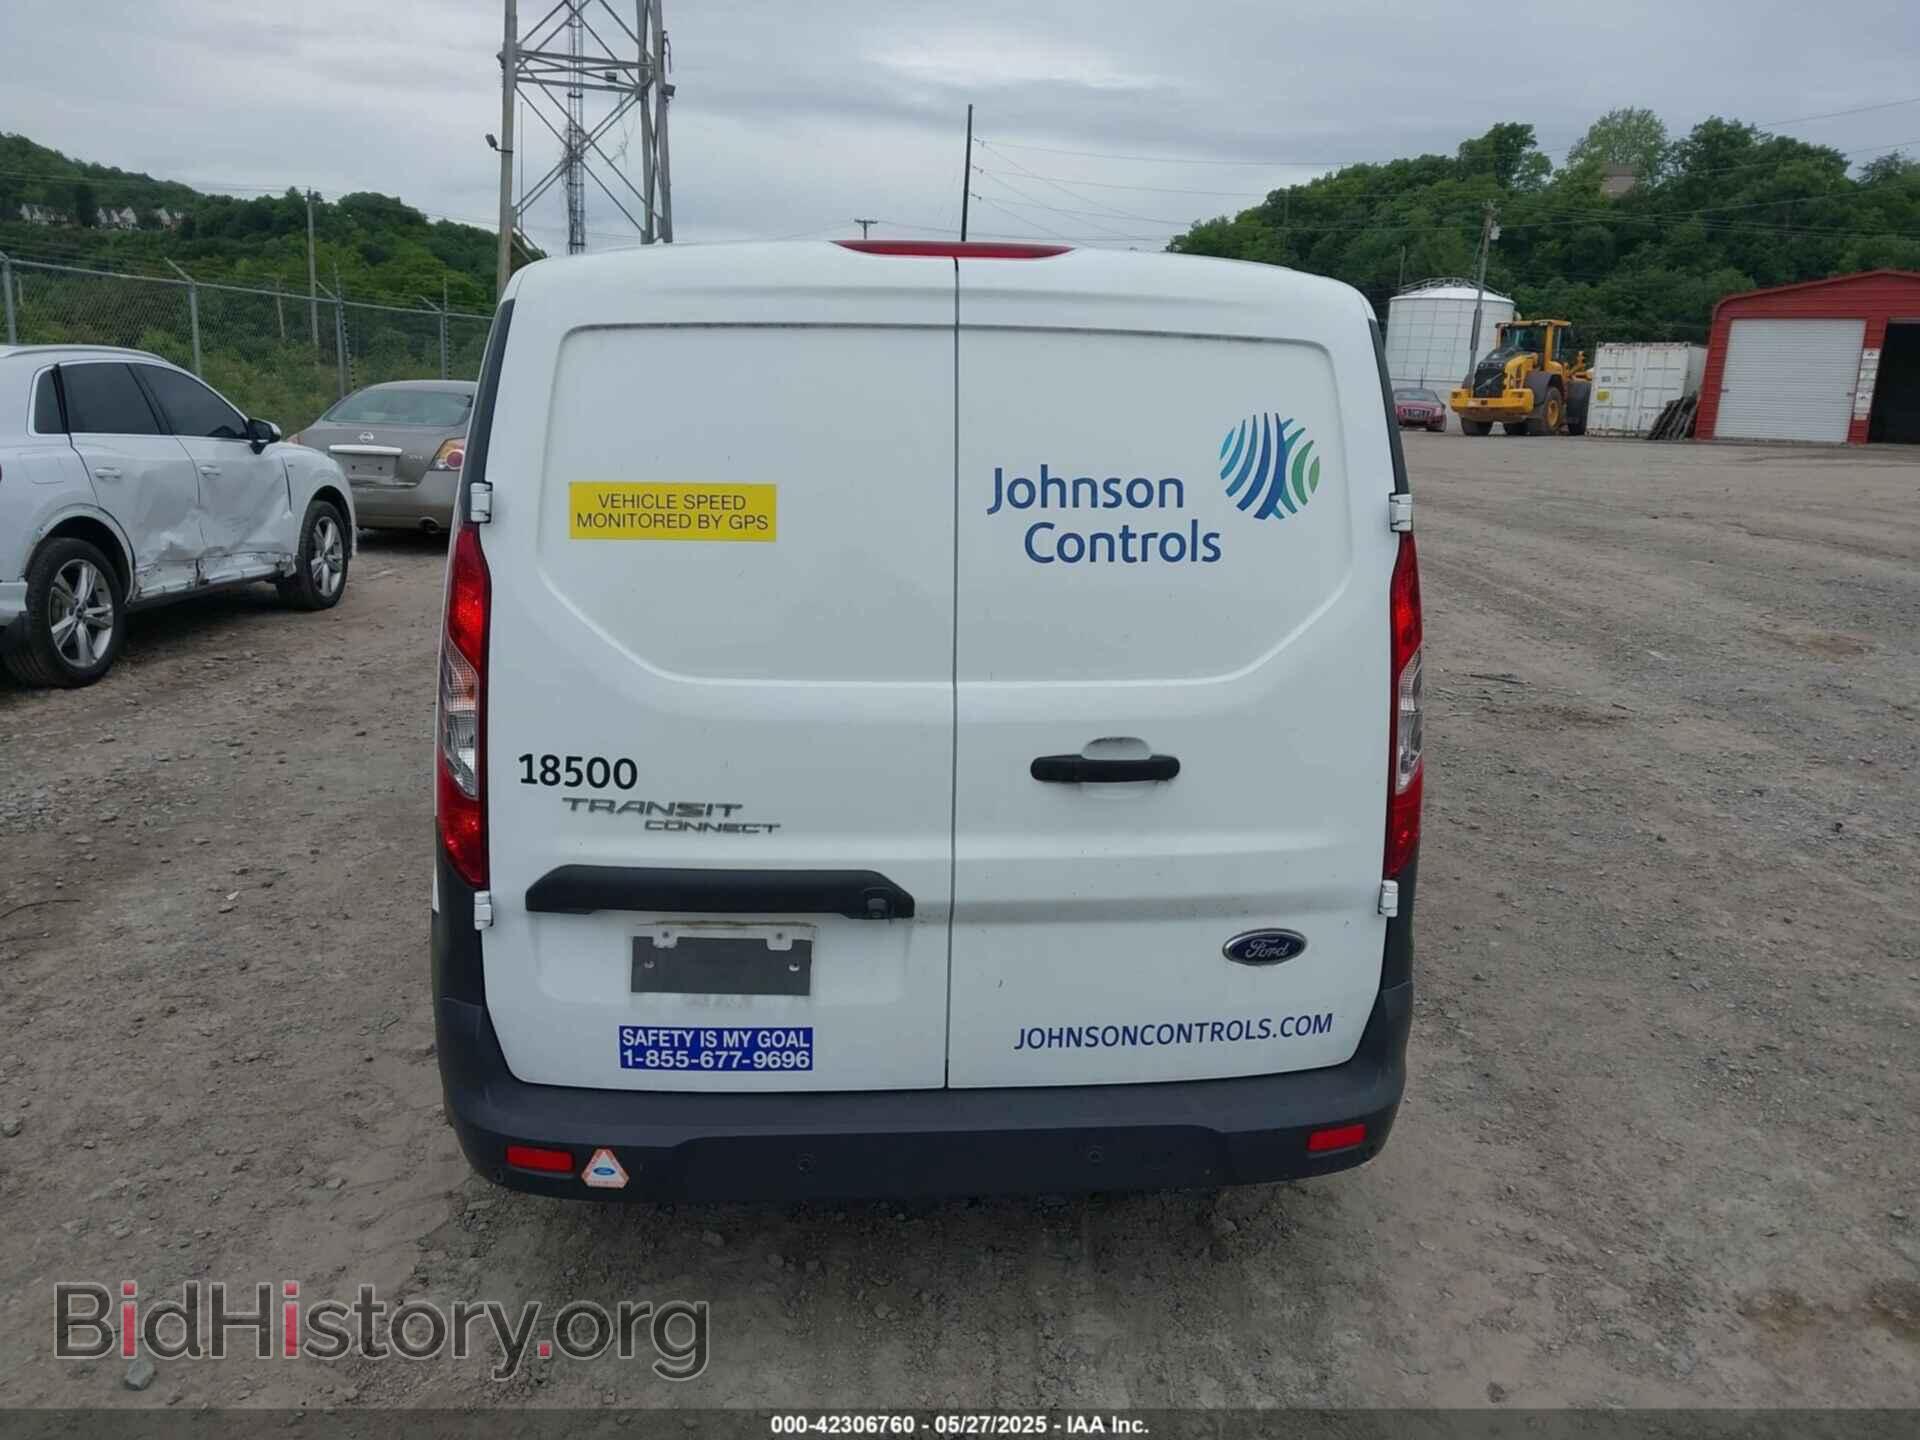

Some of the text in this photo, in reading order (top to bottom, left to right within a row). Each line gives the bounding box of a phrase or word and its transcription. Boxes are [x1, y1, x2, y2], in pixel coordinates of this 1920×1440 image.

[987, 464, 1184, 515] Johnson
[598, 493, 746, 511] VEHICLE SPEED
[576, 512, 769, 530] MONITORED BY GPS
[1024, 519, 1222, 563] Controls
[518, 753, 638, 790] 18500
[561, 796, 743, 818] TRANSIT
[644, 819, 781, 834] CONNECT
[1245, 939, 1289, 958] Ford
[622, 1028, 810, 1048] SAFETY IS MY GOAL
[1014, 1012, 1333, 1051] JOHNSONCONTROLS.COM
[623, 1049, 810, 1069] 1-855-677-9696
